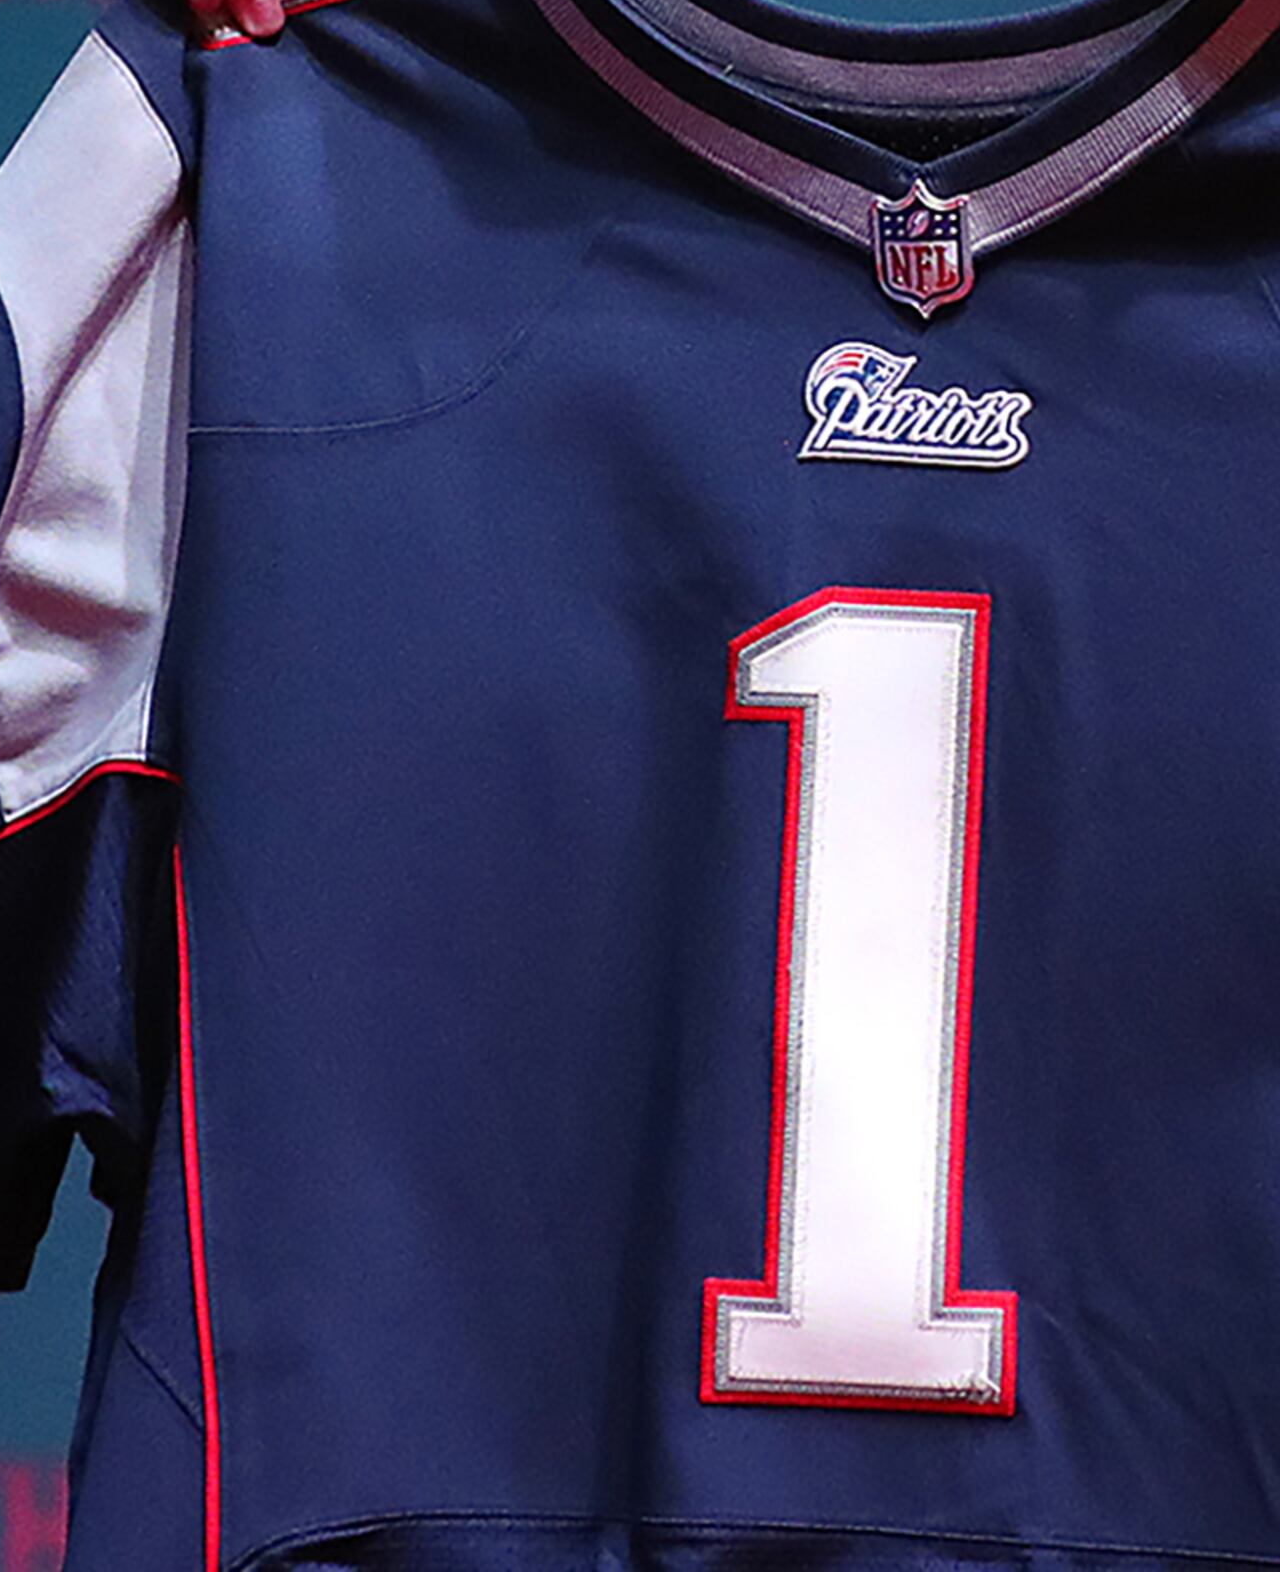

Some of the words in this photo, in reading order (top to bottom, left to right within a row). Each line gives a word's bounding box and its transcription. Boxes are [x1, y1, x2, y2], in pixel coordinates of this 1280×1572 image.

[885, 241, 961, 299] NFL
[800, 360, 1032, 464] Patriots
[700, 585, 1018, 1417] 1
